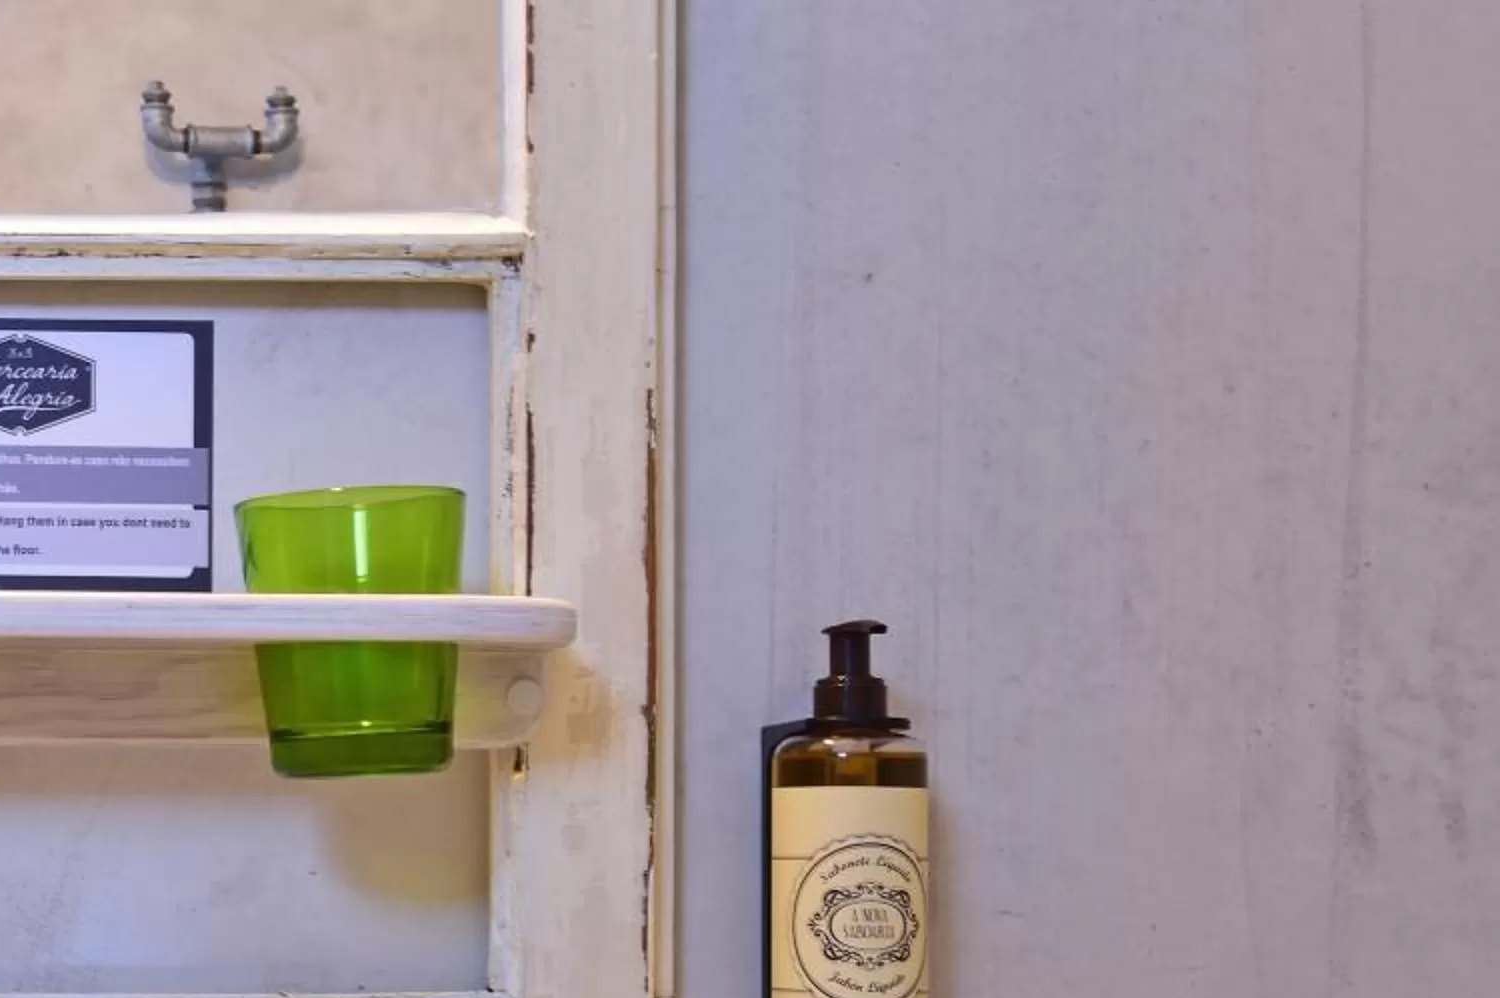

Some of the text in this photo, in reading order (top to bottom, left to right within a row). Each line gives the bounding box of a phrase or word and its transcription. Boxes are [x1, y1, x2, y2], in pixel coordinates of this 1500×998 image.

[27, 516, 54, 527] them
[57, 515, 68, 527] in
[70, 517, 96, 527] case
[99, 518, 119, 531] you
[150, 517, 176, 528] need
[179, 518, 190, 528] to
[13, 543, 42, 555] floor.
